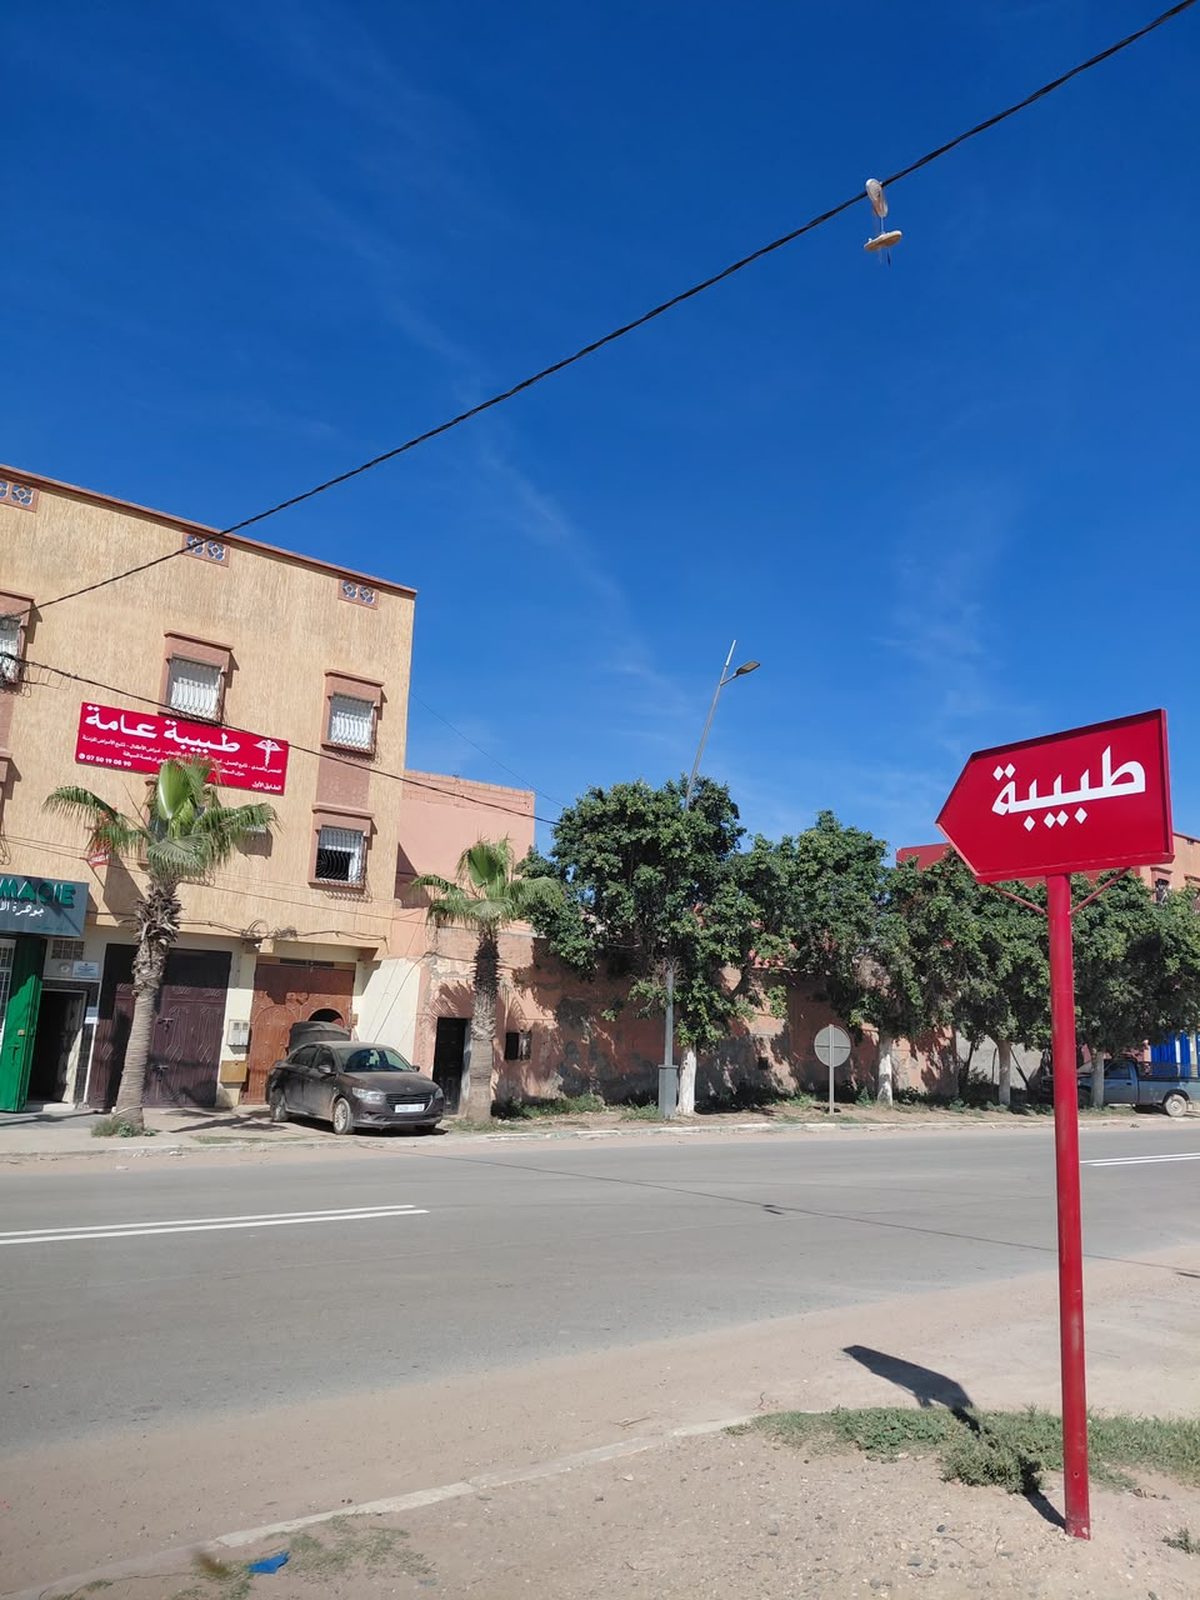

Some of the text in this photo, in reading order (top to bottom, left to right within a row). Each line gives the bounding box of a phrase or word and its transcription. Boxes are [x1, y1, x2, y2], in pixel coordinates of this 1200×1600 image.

[85, 706, 240, 752] طبيبة عامة
[992, 745, 1146, 832] طبيبة
